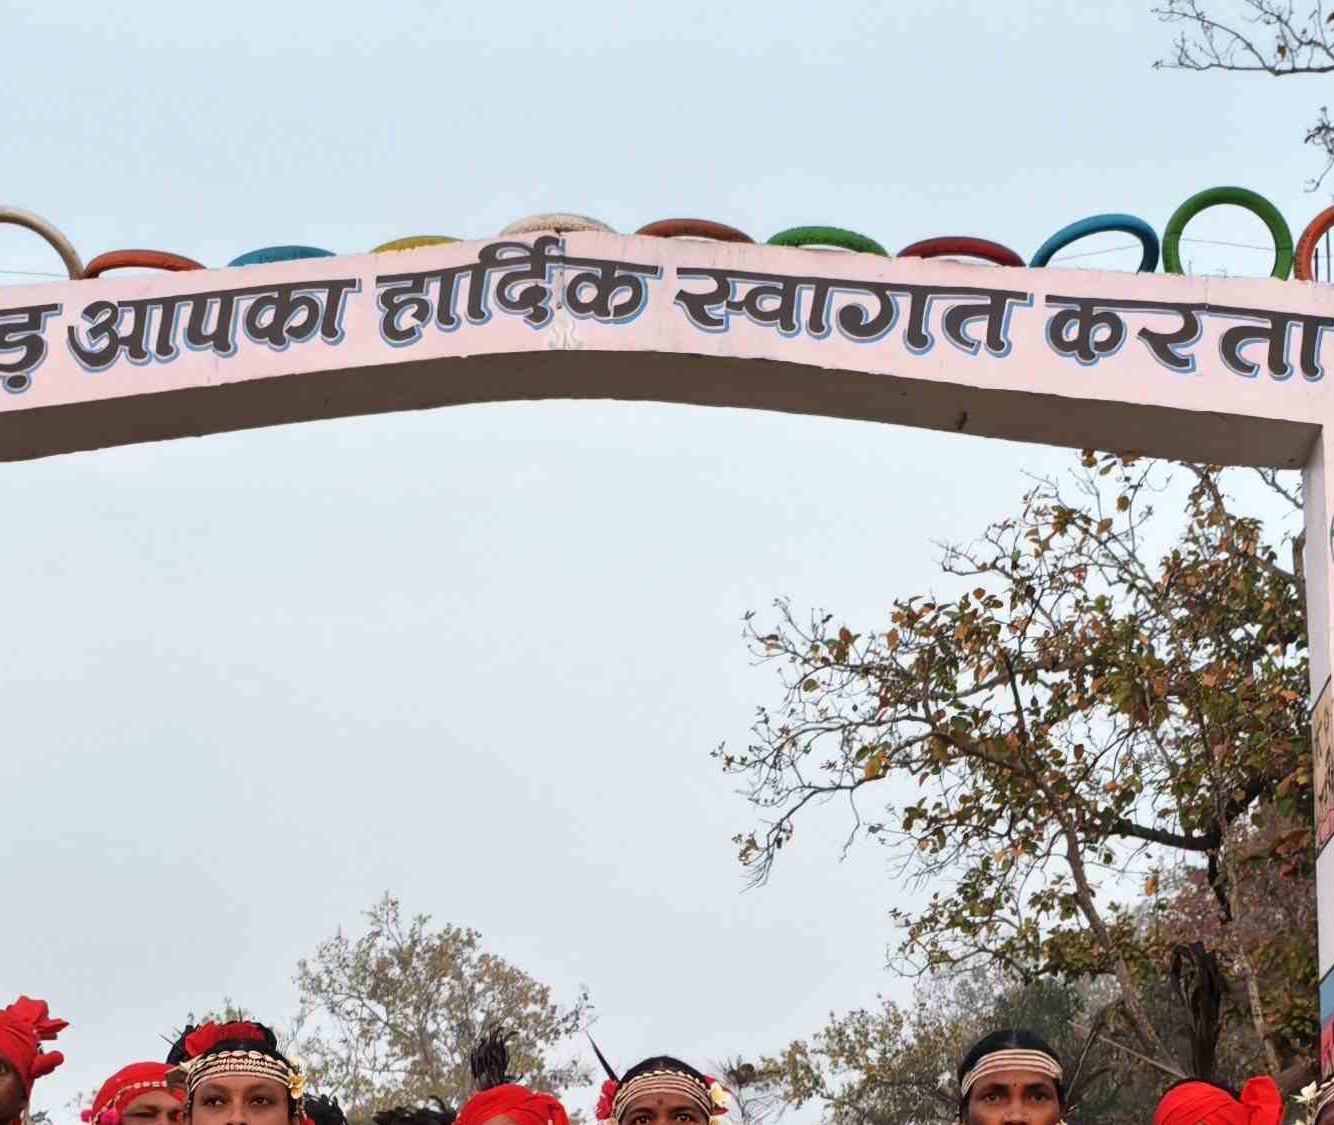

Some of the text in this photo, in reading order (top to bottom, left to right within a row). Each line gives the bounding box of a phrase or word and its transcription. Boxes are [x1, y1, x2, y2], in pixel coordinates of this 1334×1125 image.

[66, 278, 361, 373] आपका
[375, 236, 663, 349] हार्दिक
[674, 267, 1034, 357] स्वागत
